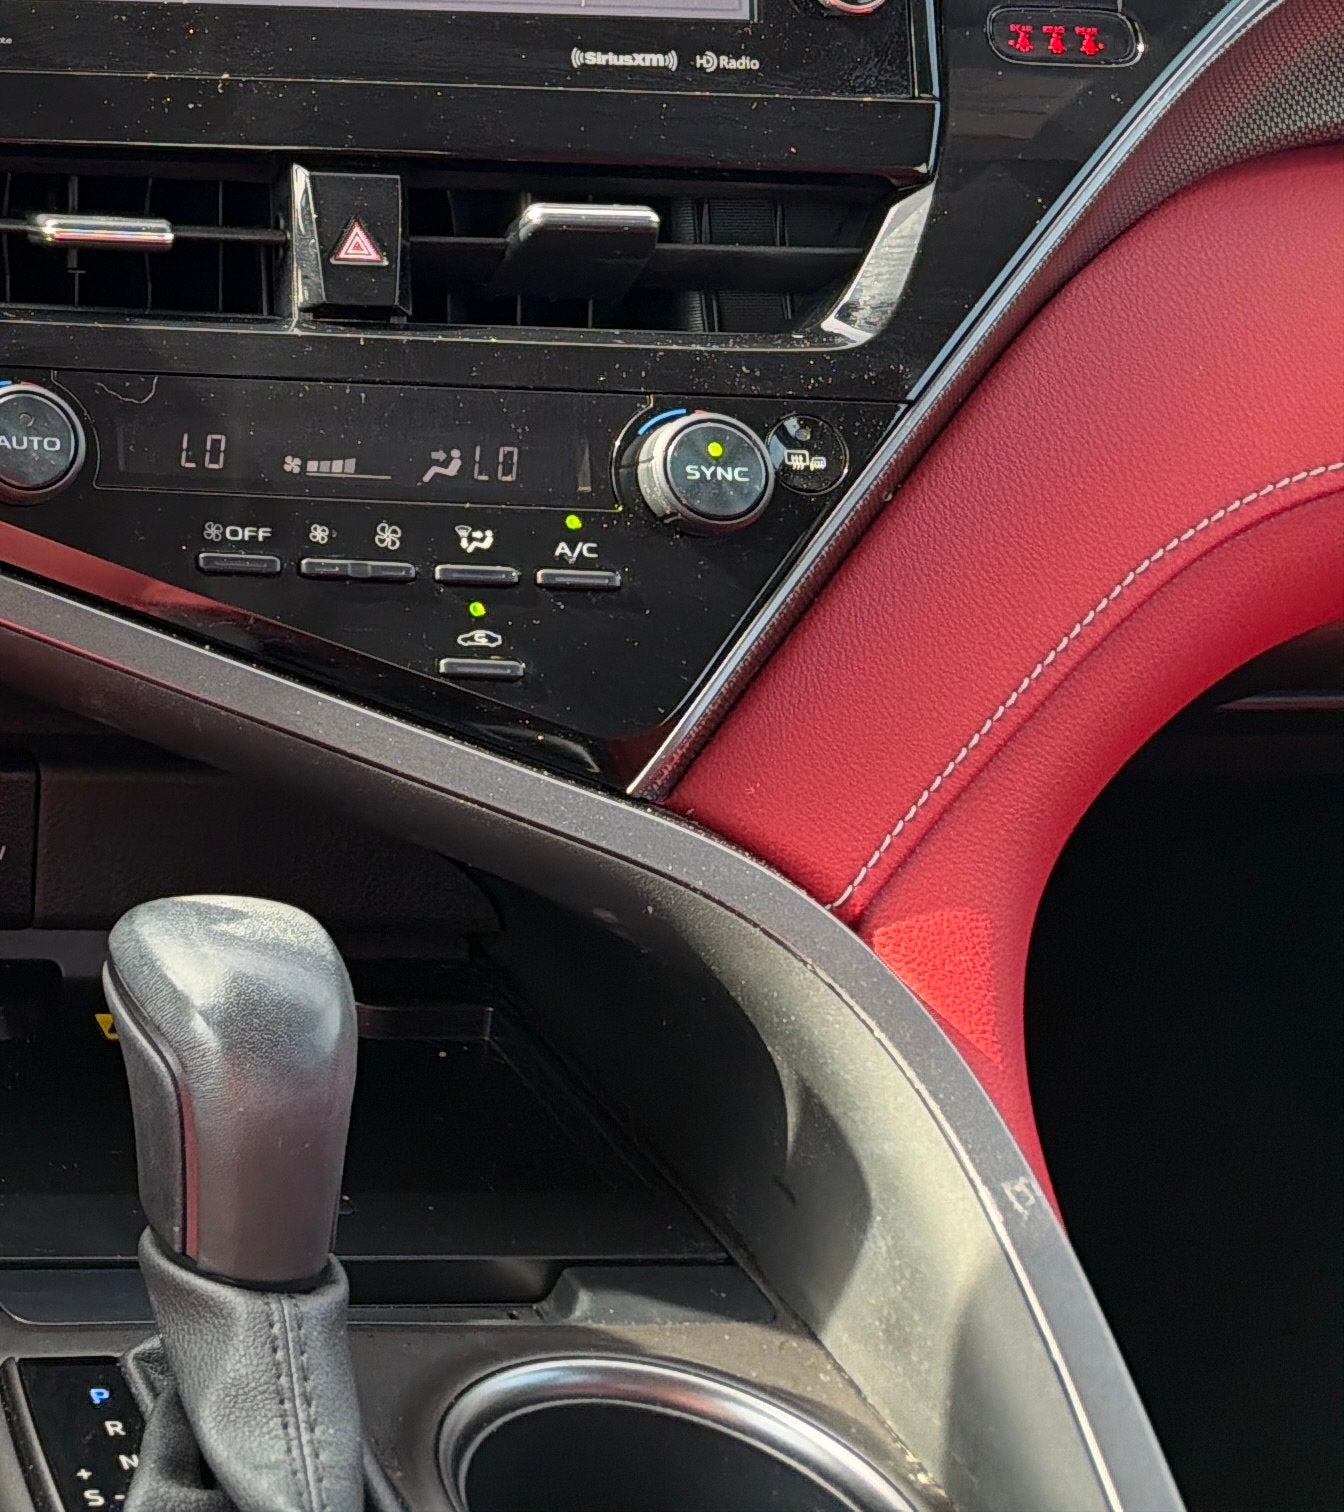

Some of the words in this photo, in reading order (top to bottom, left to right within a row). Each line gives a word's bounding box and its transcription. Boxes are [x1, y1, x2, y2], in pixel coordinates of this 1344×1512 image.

[719, 54, 760, 70] Radio
[685, 464, 751, 482] SYNC
[225, 525, 272, 541] OFF
[554, 541, 599, 559] A/C
[89, 1388, 110, 1405] P
[104, 1420, 126, 1437] R
[118, 1454, 139, 1471] N
[83, 1489, 105, 1507] S
